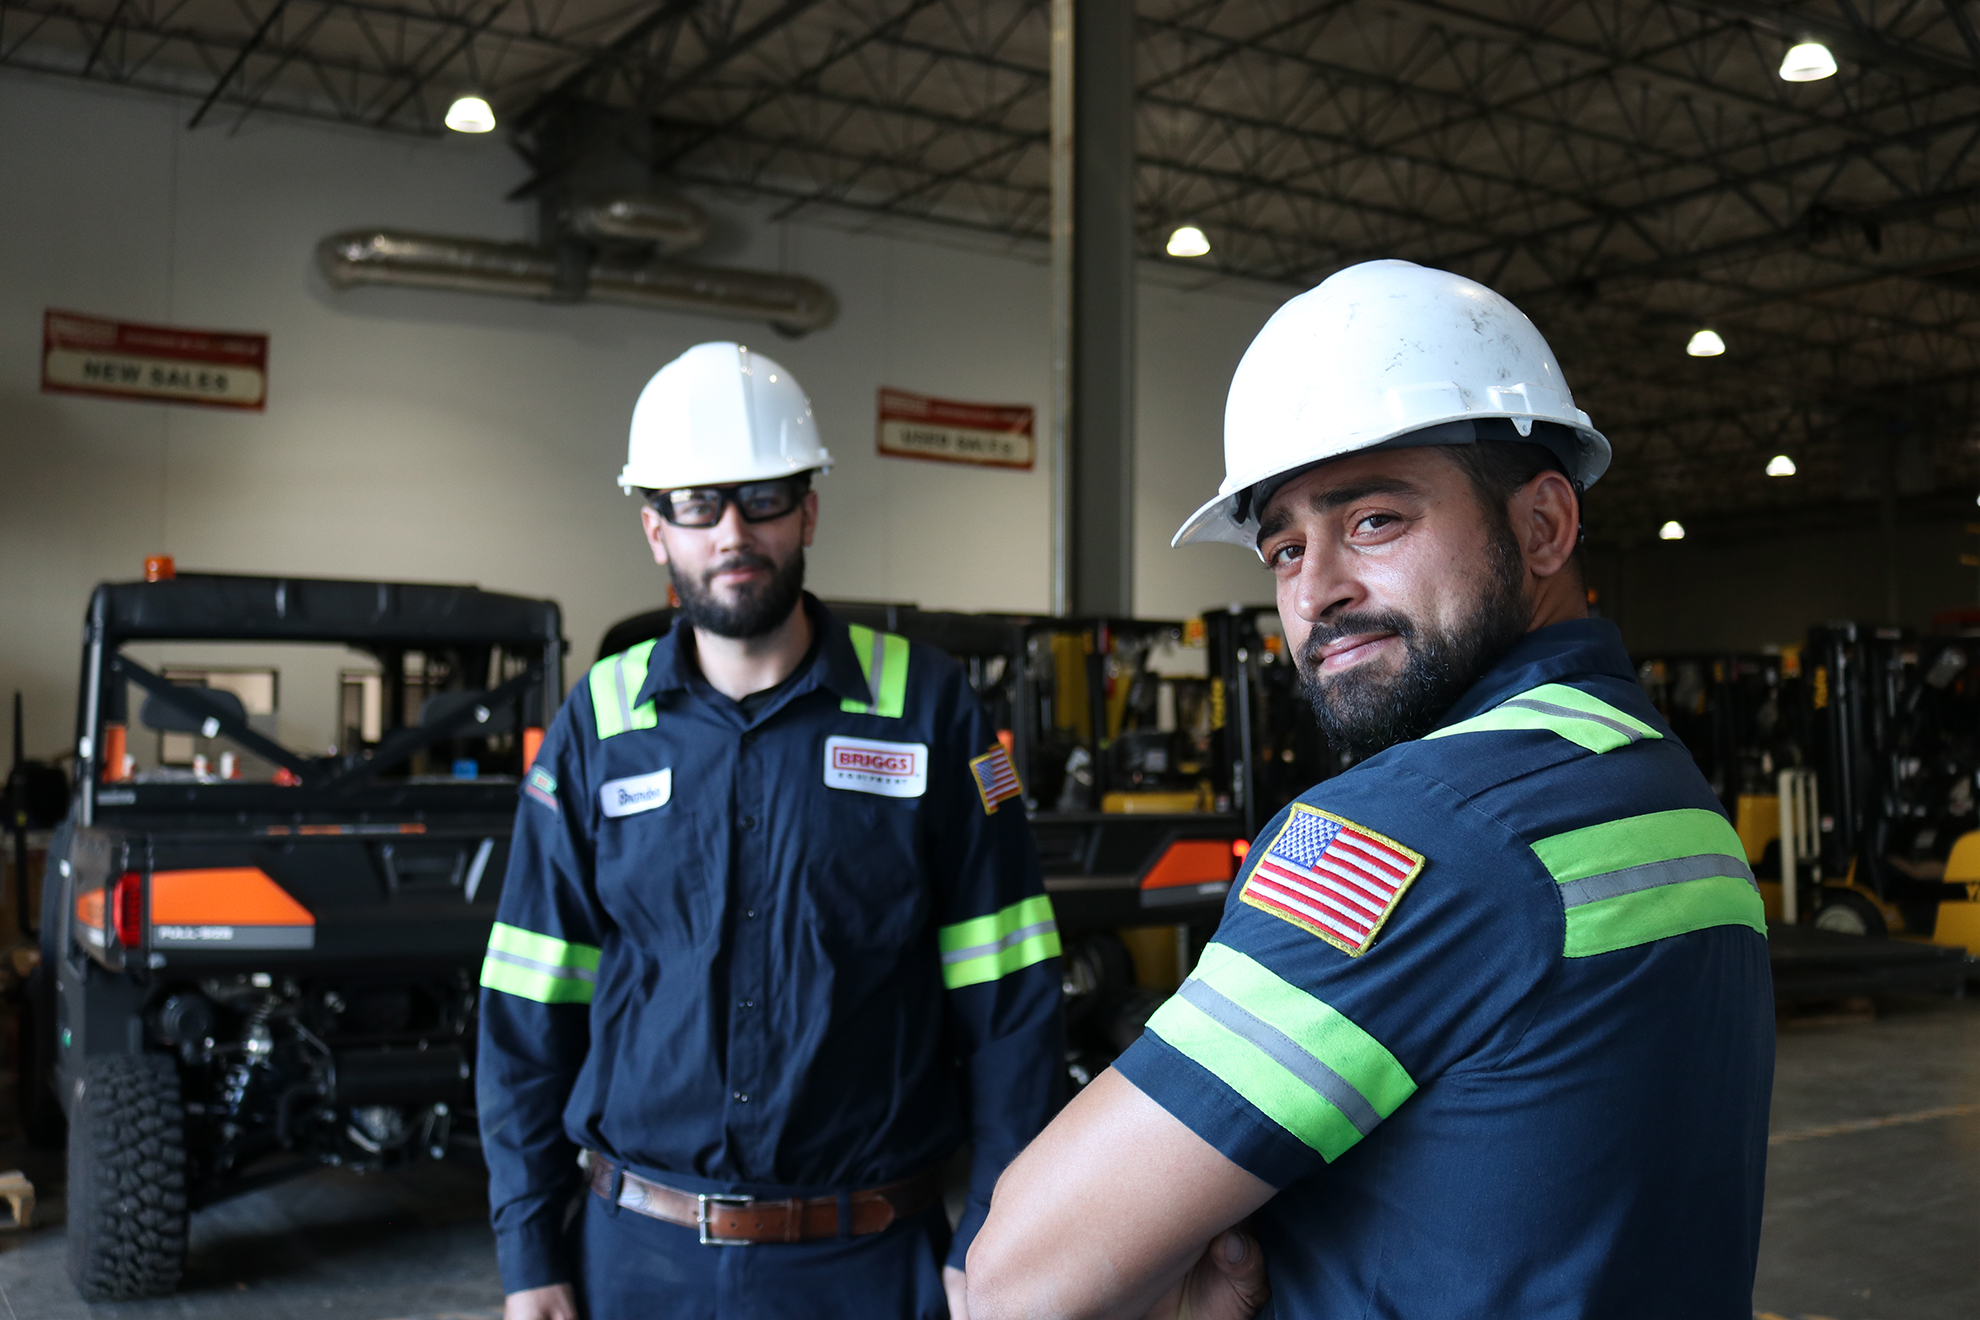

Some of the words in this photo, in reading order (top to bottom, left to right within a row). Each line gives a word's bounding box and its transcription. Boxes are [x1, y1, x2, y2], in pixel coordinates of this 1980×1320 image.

[84, 359, 141, 383] NEW
[151, 367, 228, 392] SALES
[840, 752, 907, 770] BRIGGS
